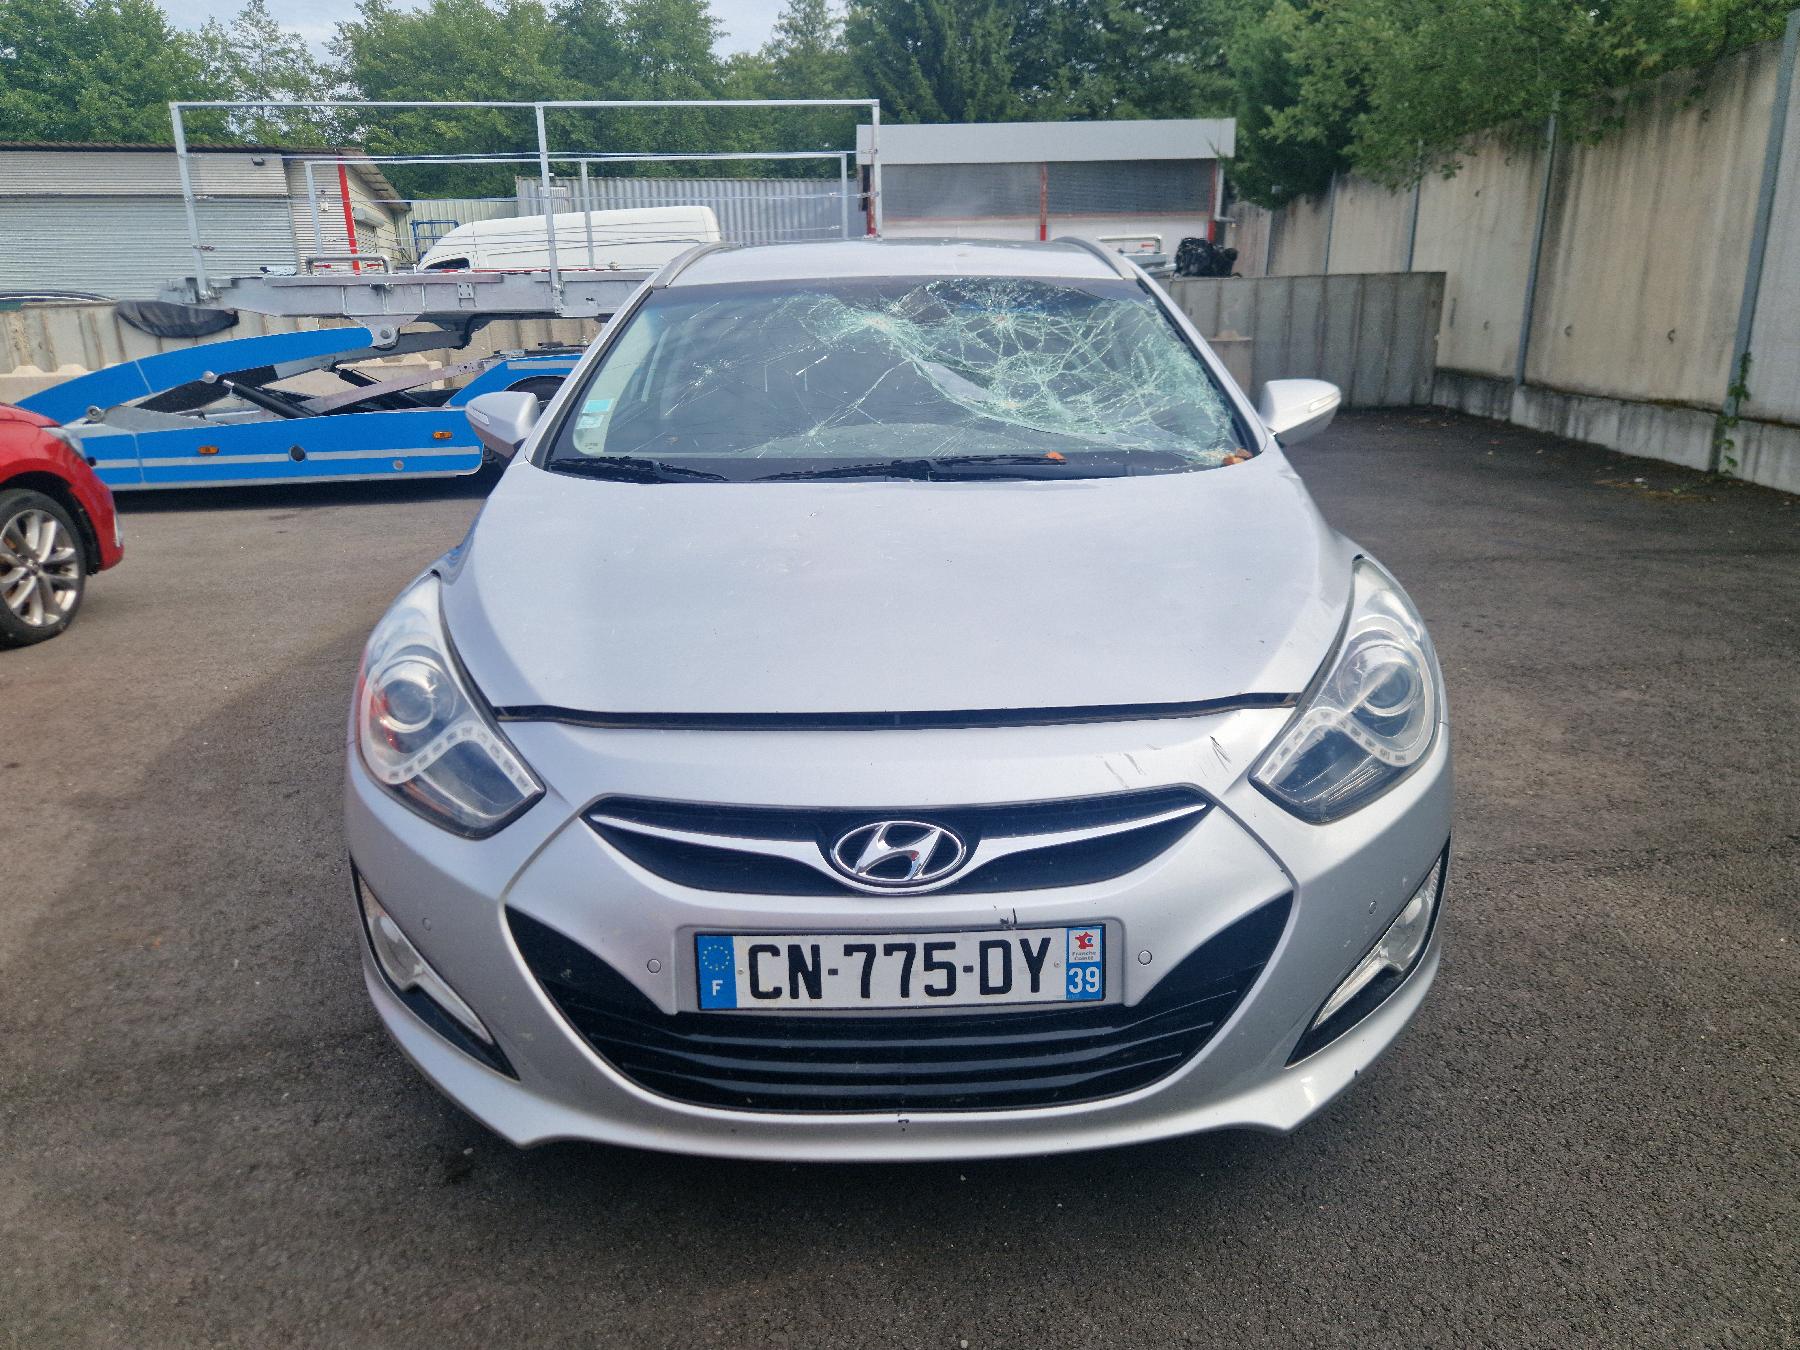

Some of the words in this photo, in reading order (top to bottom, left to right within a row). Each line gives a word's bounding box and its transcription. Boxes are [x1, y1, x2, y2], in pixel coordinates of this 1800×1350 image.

[748, 937, 1051, 1000] CN-775-DY
[1069, 966, 1100, 994] 39
[712, 979, 724, 996] F
